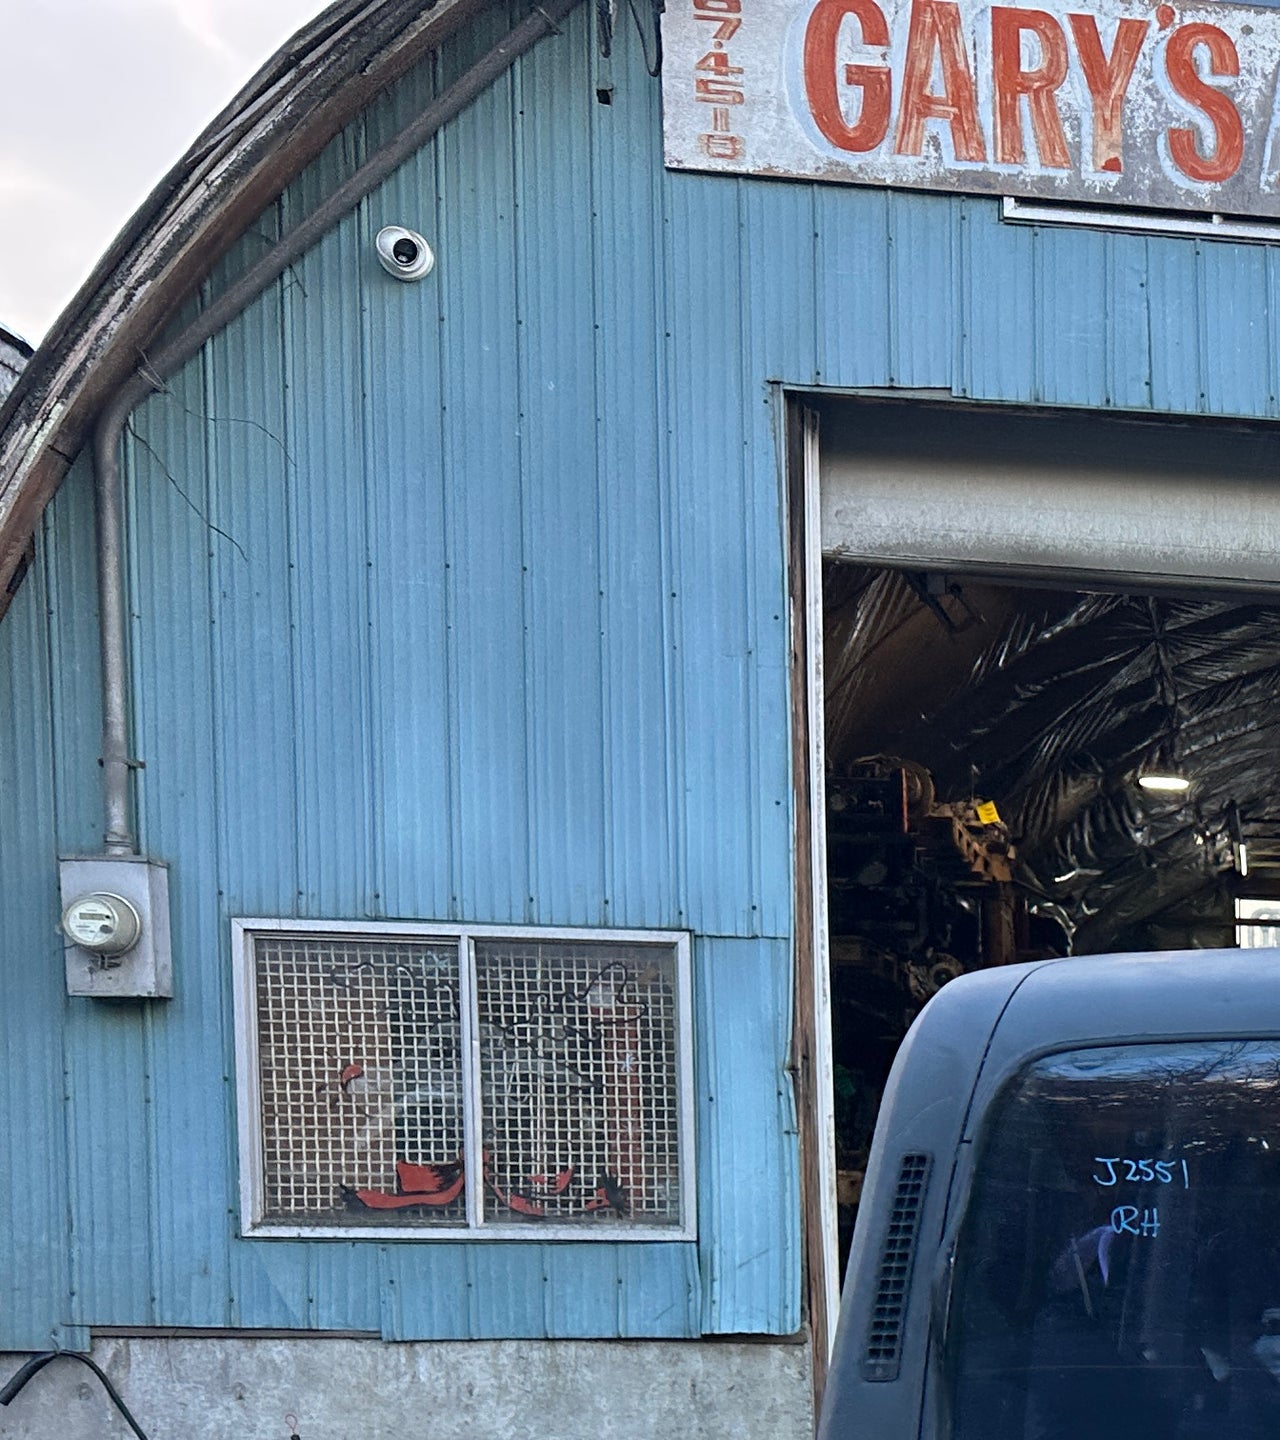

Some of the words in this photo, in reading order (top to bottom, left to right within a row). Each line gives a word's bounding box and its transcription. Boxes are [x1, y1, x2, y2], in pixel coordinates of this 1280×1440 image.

[804, 0, 1243, 184] GARY'S
[1093, 1157, 1190, 1189] J2551
[1111, 1205, 1161, 1238] RH
